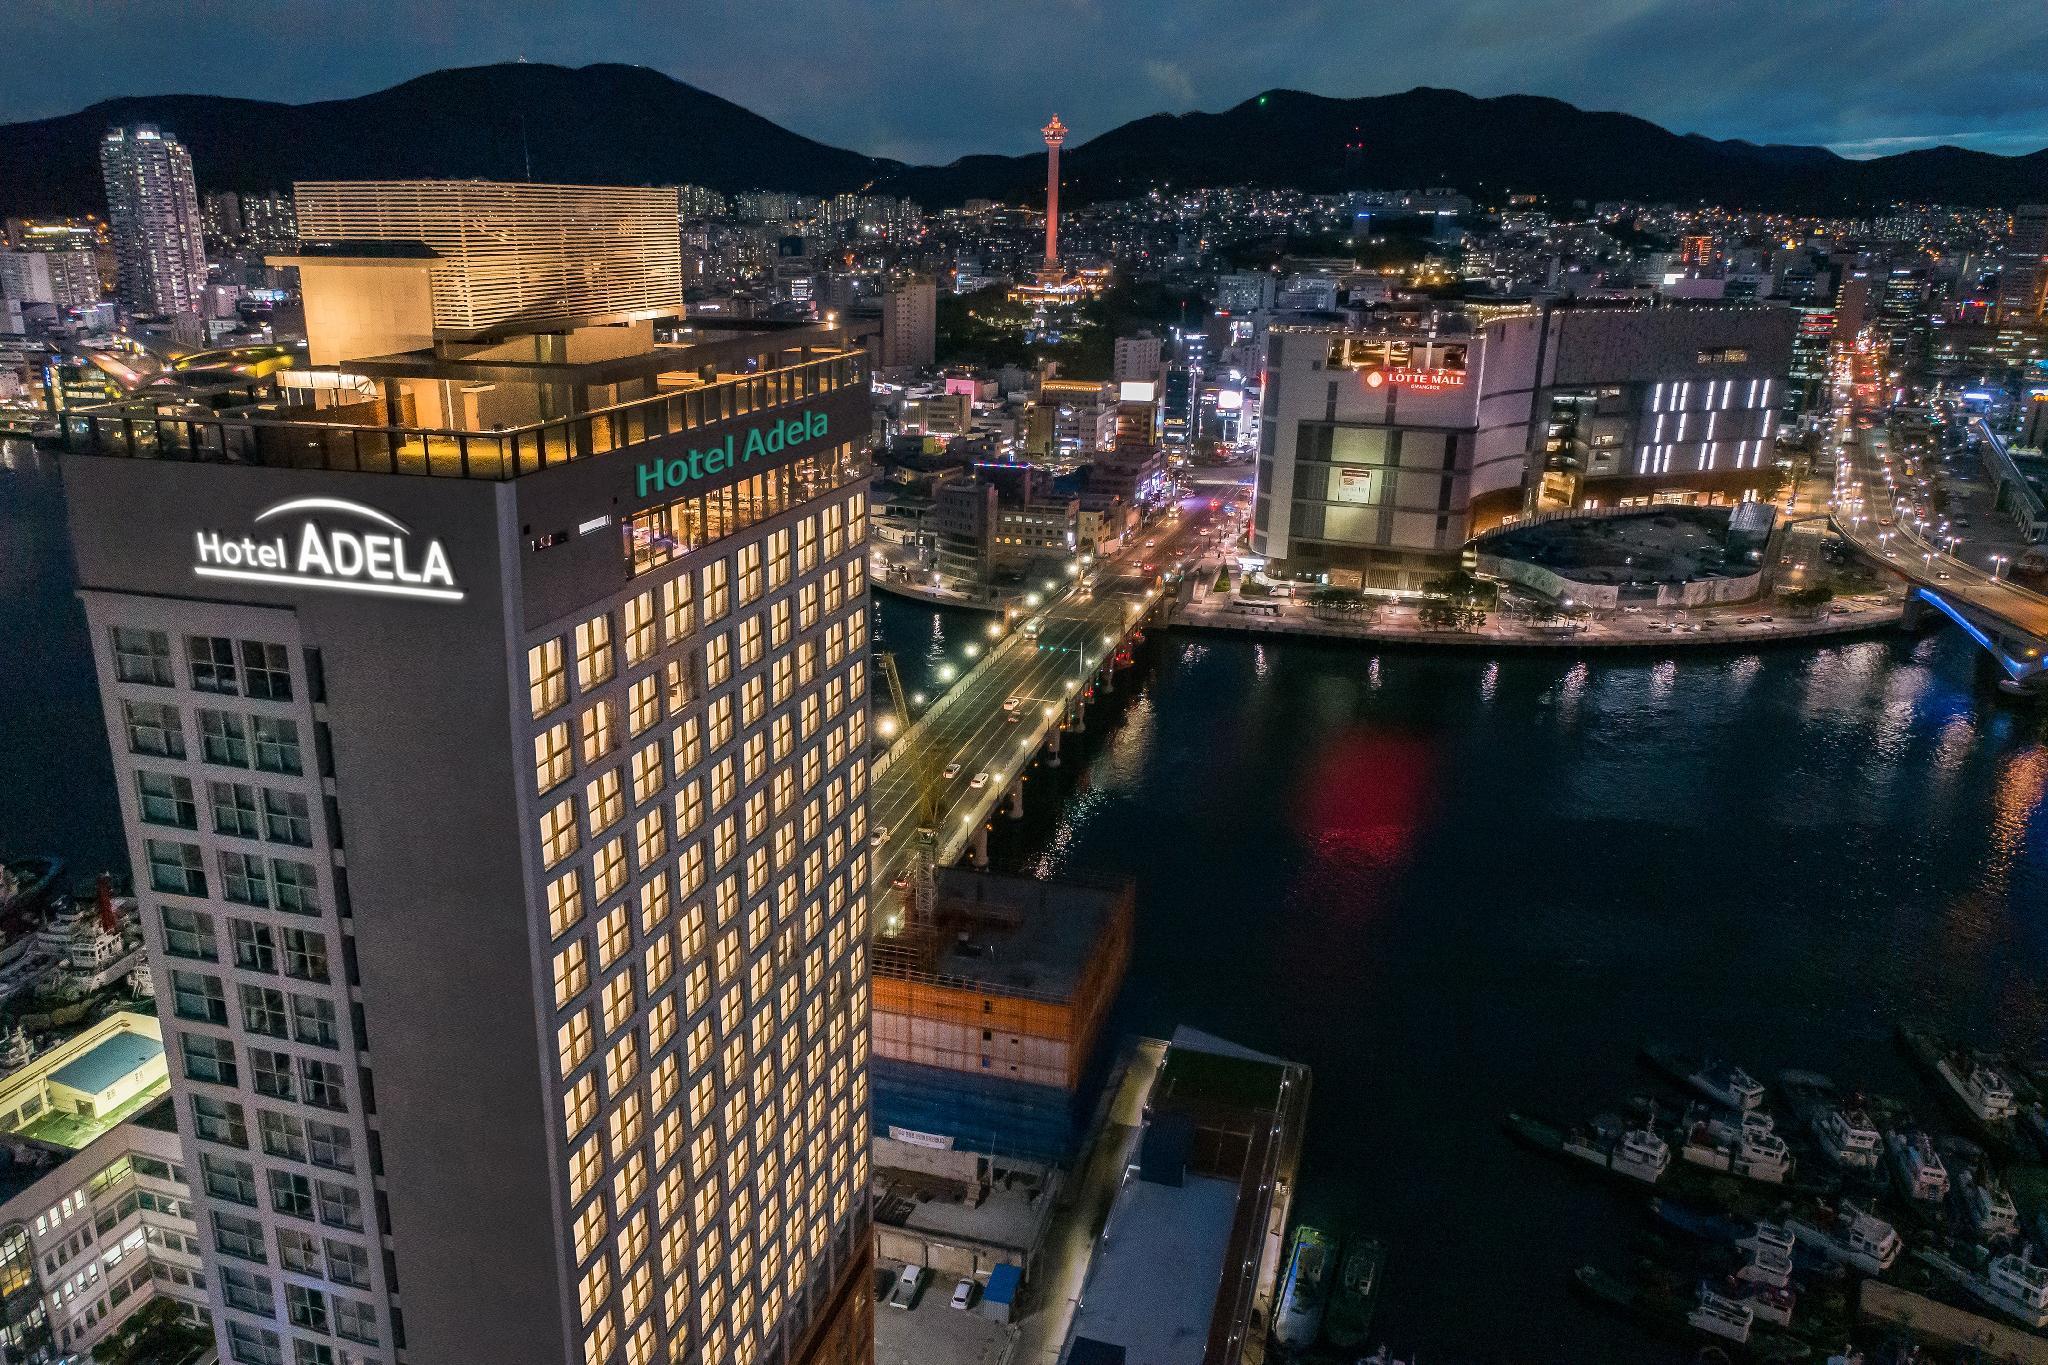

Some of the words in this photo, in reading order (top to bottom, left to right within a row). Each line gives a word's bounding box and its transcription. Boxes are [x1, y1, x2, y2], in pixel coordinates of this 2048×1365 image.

[1389, 373, 1427, 383] LOTTE
[1431, 375, 1464, 385] MALL
[635, 434, 734, 498] Hotel
[742, 410, 828, 463] Adela
[197, 531, 286, 569] Hotel
[298, 522, 454, 585] ADELA
